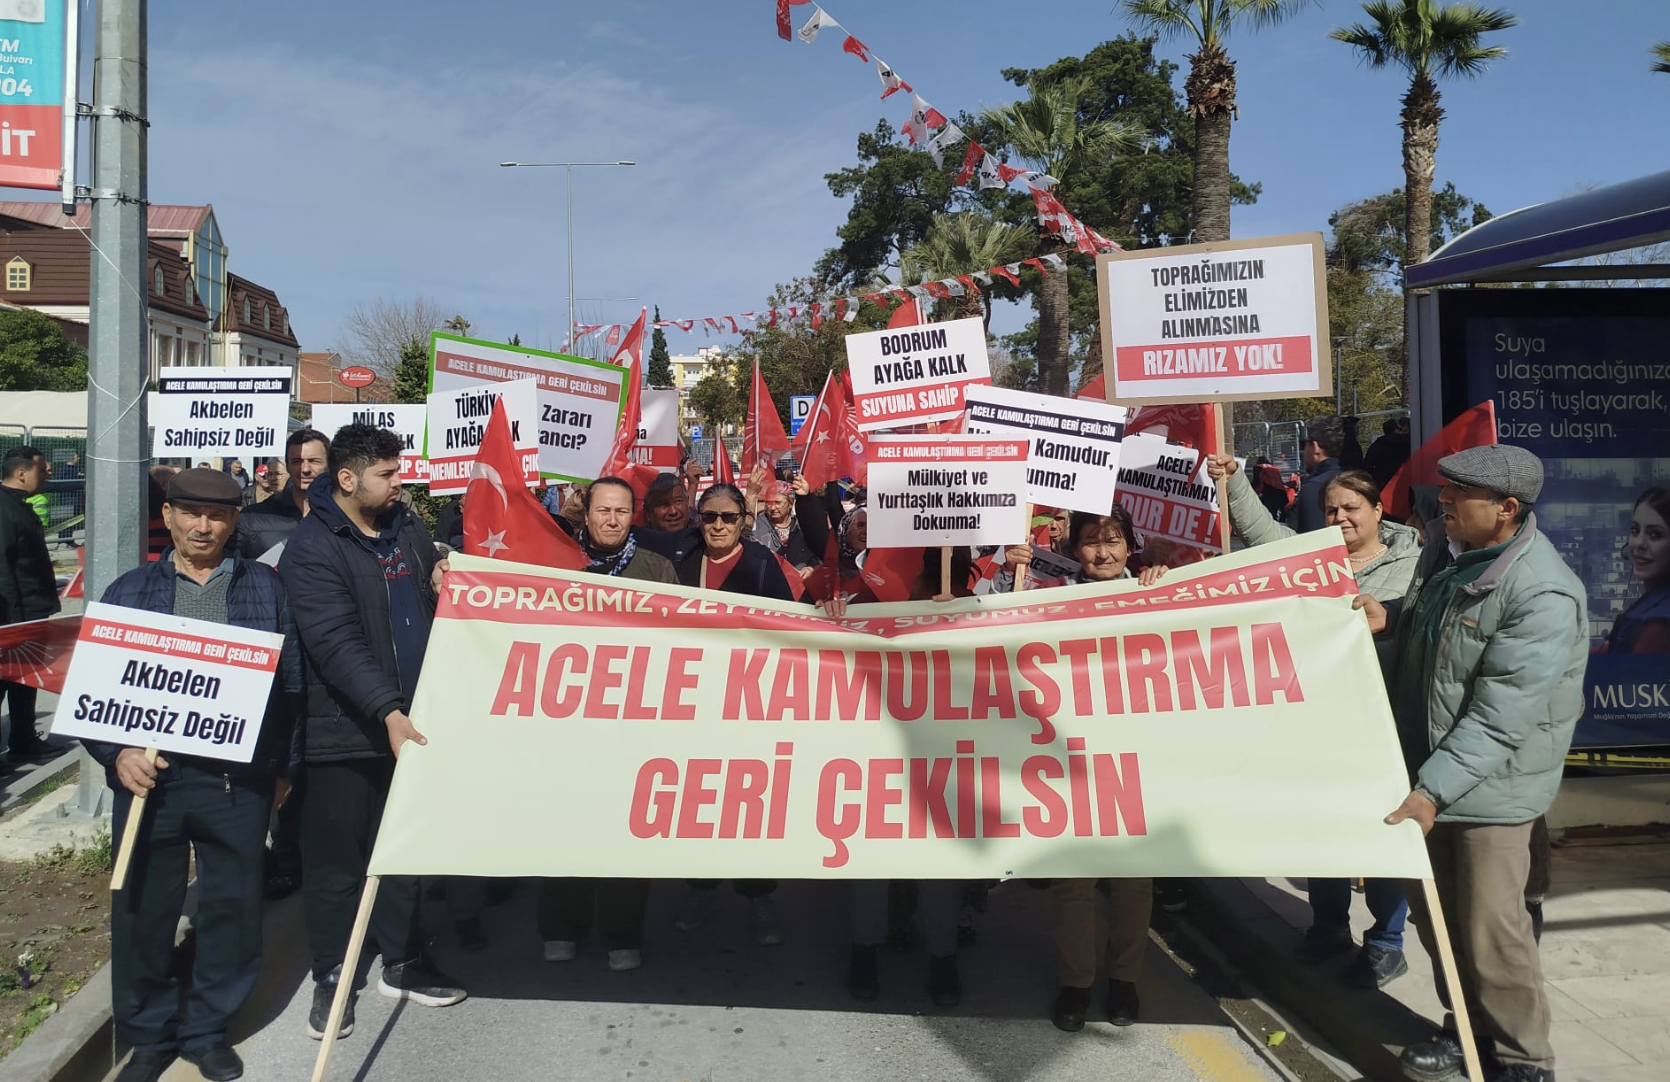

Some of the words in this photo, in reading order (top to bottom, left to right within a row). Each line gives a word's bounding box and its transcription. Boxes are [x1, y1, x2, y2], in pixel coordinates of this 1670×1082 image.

[0, 66, 15, 75] LA
[0, 79, 33, 97] 04
[0, 121, 36, 156] İT
[1151, 259, 1264, 287] TOPRAĞIMIZIN
[1164, 287, 1248, 312] ELİMİZDEN
[1161, 313, 1260, 339] ALINMASINA
[880, 329, 947, 356] BODRUM
[1495, 333, 1545, 357] Suya
[874, 356, 924, 385] AYAĞA
[928, 354, 967, 377] KALK
[1143, 347, 1228, 376] RIZAMIZ
[1233, 343, 1284, 371] YOK!
[166, 381, 185, 391] ACELE
[186, 381, 237, 393] KAMULAŞTIRMA
[238, 379, 253, 390] GERİ
[254, 379, 282, 393] ÇEKİLSİN
[448, 359, 474, 373] ACELE
[548, 376, 568, 389] GERİ
[569, 378, 608, 396] ÇEKİLSİN
[190, 401, 253, 418] Akbelen
[455, 389, 498, 419] TÜRKİY
[798, 400, 809, 416] D
[861, 396, 916, 417] SUYUNA
[919, 385, 958, 409] SAHİP
[1551, 389, 1668, 415] tuşlayarak,
[541, 404, 592, 429] Zararı
[972, 405, 996, 419] ACELE
[997, 409, 1059, 428] KAMULAŞTIRMA
[1060, 418, 1079, 432] GERİ
[1080, 421, 1116, 437] ÇEKİLSİN
[165, 428, 230, 449] Sahipsiz
[235, 426, 275, 448] Değil
[446, 420, 484, 449] AYAĞA
[539, 429, 587, 450] ancı?
[1498, 418, 1542, 438] bize
[1550, 418, 1617, 444] ulaşın.
[878, 446, 900, 458] ACELE
[903, 446, 964, 460] KAMULAŞTIRMA
[967, 445, 983, 457] GERİ
[1035, 438, 1114, 470] Kamudur,
[1156, 455, 1194, 476] ACELE
[430, 460, 475, 482] MEMLEK
[908, 469, 967, 487] Mülkiyet
[972, 471, 988, 485] ve
[1027, 467, 1077, 491] unma!
[1117, 467, 1218, 503] KAMULAŞTIRMAY
[878, 492, 944, 513] Yurttaşlık
[948, 492, 1016, 508] Hakkımıza
[914, 514, 980, 530] Dokunma!
[1168, 504, 1201, 540] DE
[1204, 514, 1217, 543] !
[1279, 558, 1353, 592] İÇİN
[91, 624, 123, 641] ACELE
[124, 629, 202, 653] KAMULAŞTIRMA
[203, 643, 227, 659] GERİ
[226, 647, 269, 665] ÇEKİLSİN
[120, 659, 221, 699] Akbelen
[490, 640, 704, 720] ACELE
[722, 621, 1305, 745] KAMULAŞTIRMA
[1593, 683, 1670, 709] MUSK
[74, 694, 180, 733] Sahipsiz
[182, 711, 247, 745] Değil
[628, 741, 794, 840] GERİ
[815, 737, 1148, 869] ÇEKİLSİN
